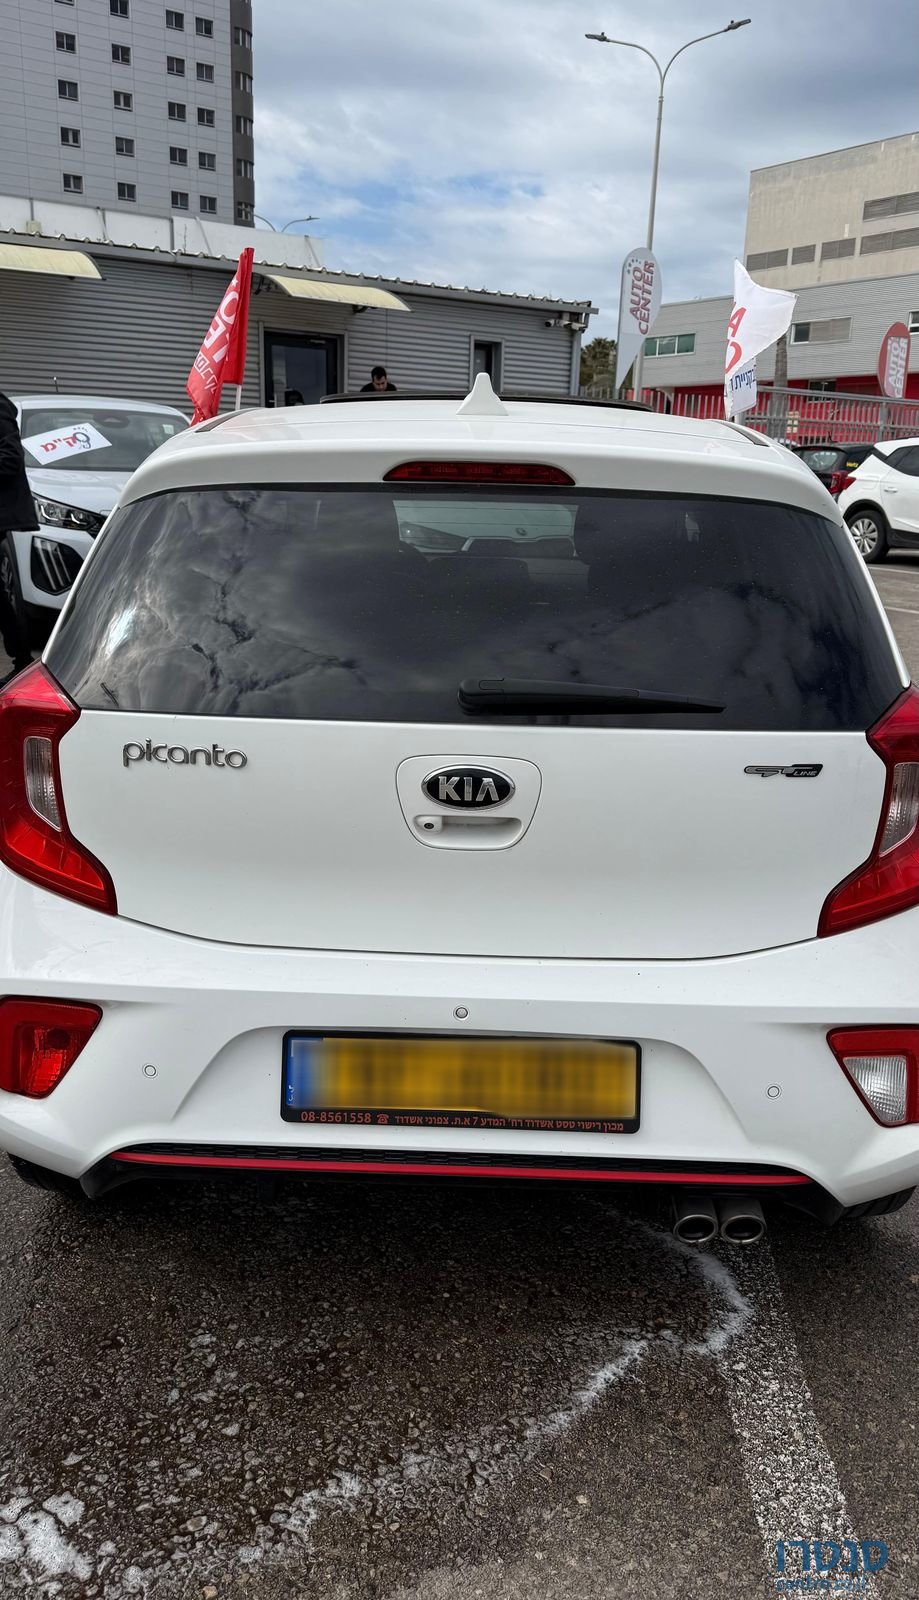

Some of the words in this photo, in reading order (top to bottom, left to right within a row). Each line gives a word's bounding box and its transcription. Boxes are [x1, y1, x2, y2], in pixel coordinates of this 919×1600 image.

[630, 266, 643, 321] AUTO
[638, 259, 655, 335] CENTER
[888, 342, 900, 387] AUTO
[122, 737, 248, 769] picanto
[438, 775, 500, 801] KIA
[301, 1111, 372, 1124] 08-8561558
[395, 1115, 423, 1125] אשדוד
[425, 1116, 449, 1126] צפוני
[472, 1116, 479, 1126] 7
[480, 1117, 506, 1127] המדע
[525, 1119, 554, 1129] אשדוד
[556, 1120, 576, 1129] טסט
[577, 1120, 601, 1131] רישוי
[603, 1122, 624, 1133] מכון
